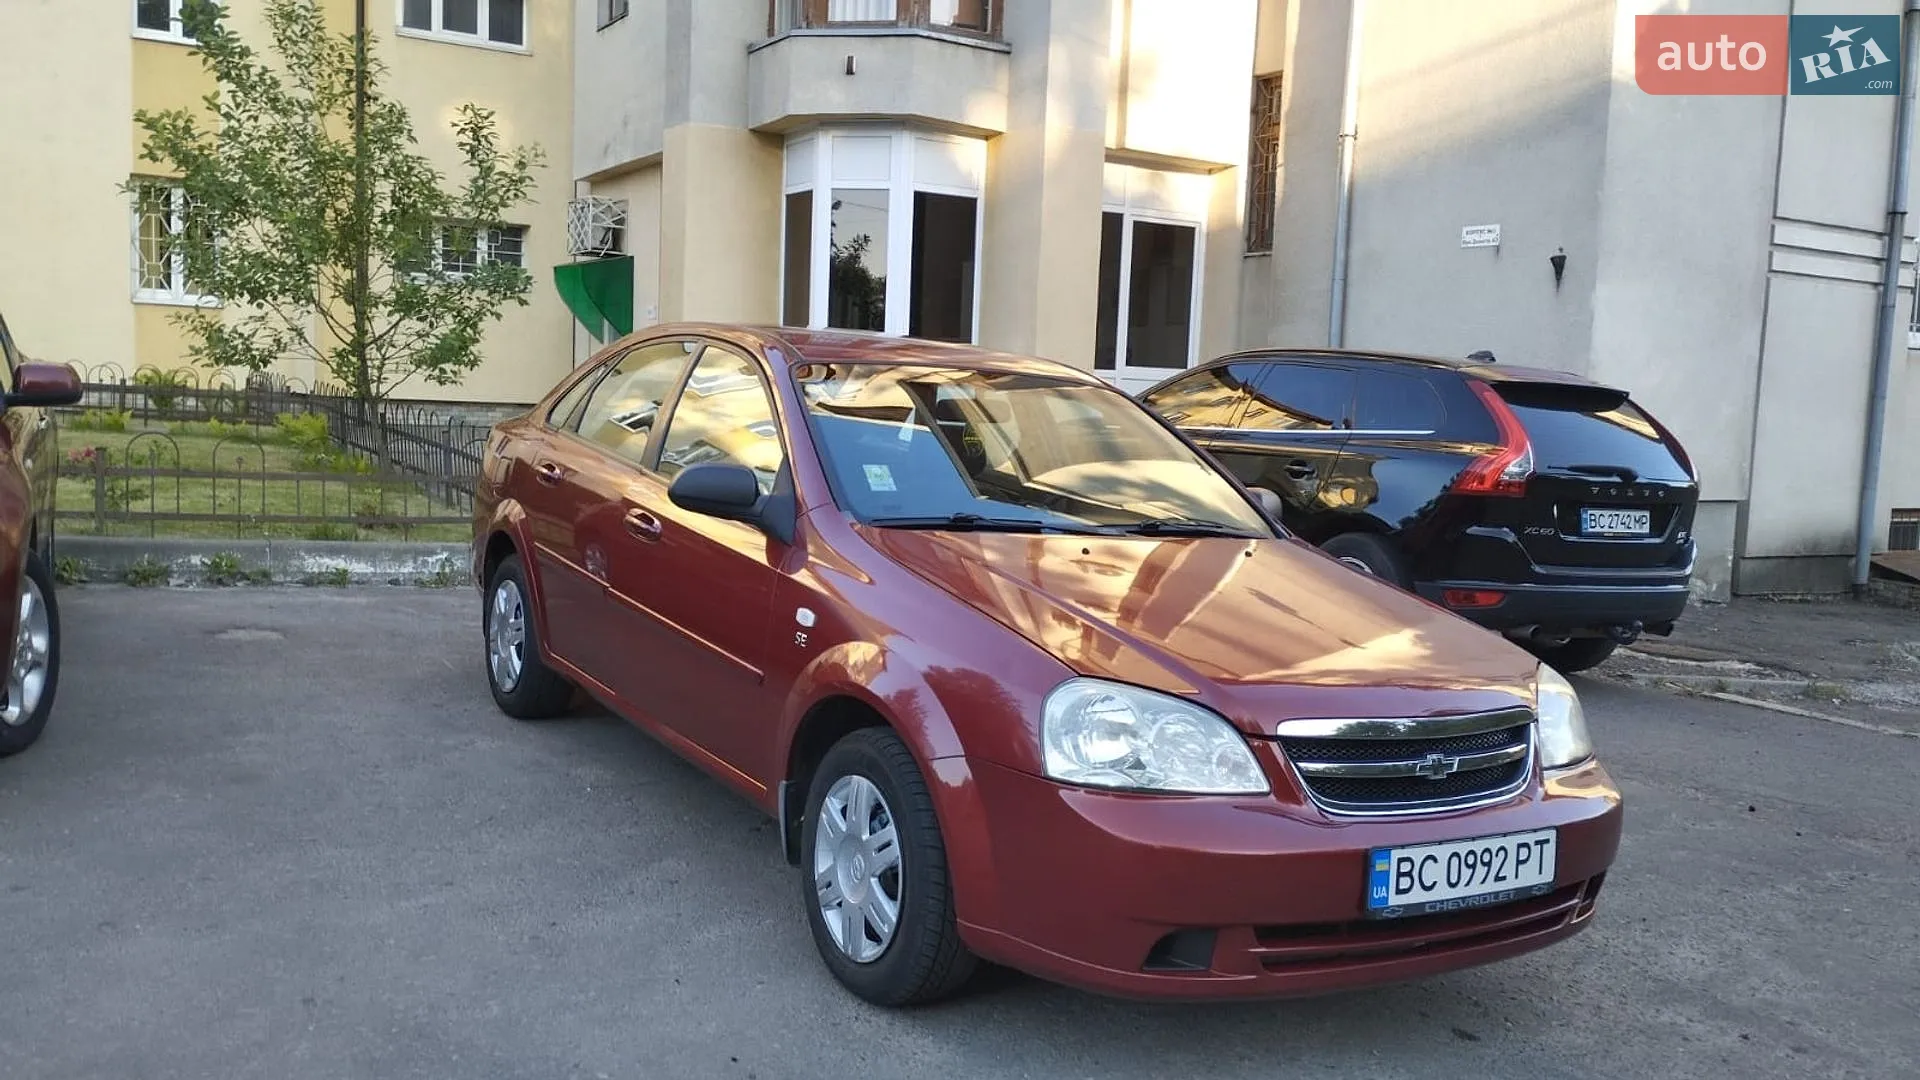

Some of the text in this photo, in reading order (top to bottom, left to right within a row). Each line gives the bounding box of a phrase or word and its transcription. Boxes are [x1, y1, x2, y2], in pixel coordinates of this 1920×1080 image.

[1589, 513, 1606, 529] BC
[1607, 514, 1632, 529] 2742
[795, 631, 808, 648] SE
[1395, 838, 1551, 895] BC 0992 PT
[1373, 886, 1388, 899] UA
[1424, 891, 1516, 912] CHEVROLET
